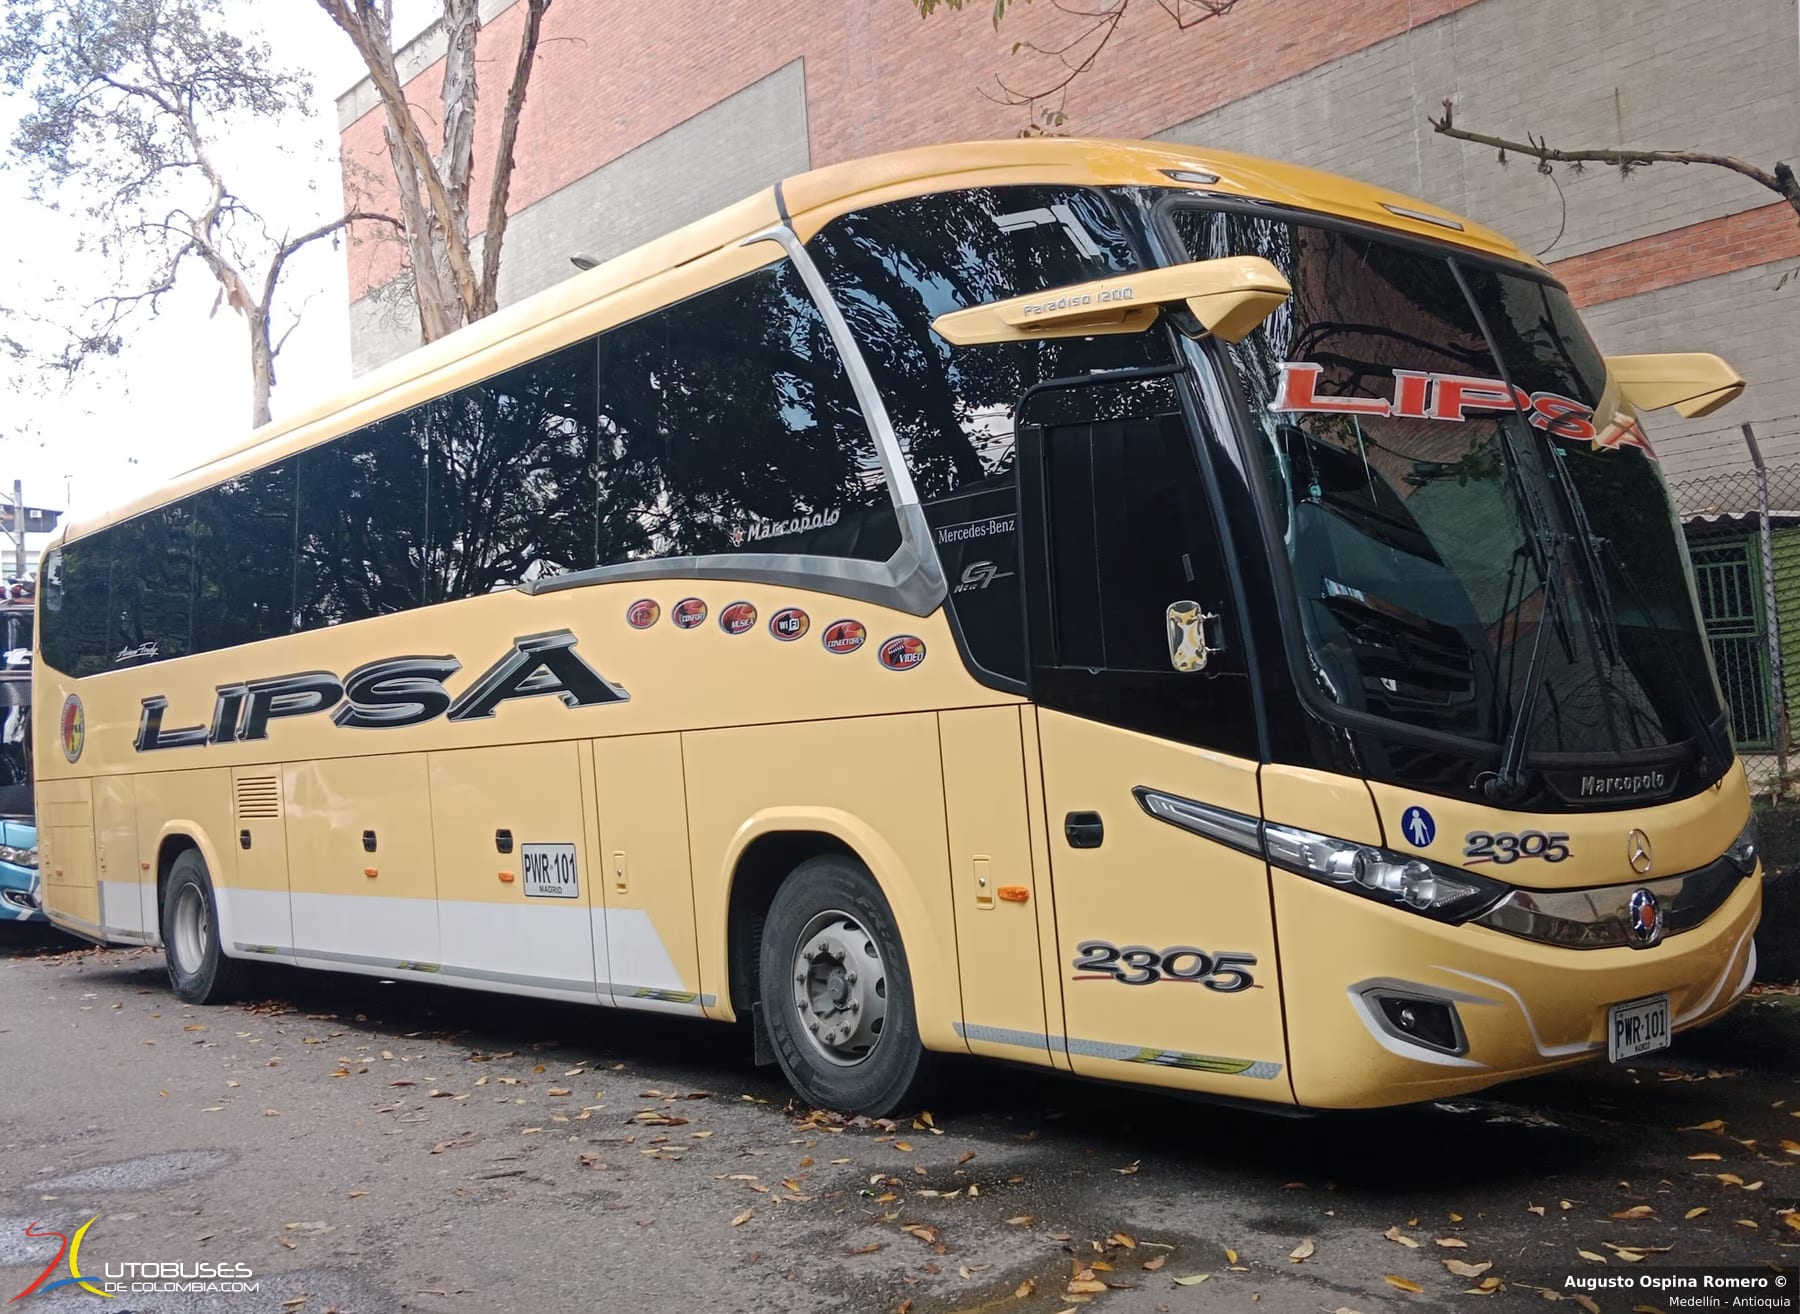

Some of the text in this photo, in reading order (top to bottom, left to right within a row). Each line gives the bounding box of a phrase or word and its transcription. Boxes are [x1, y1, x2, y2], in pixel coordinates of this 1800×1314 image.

[1023, 287, 1134, 316] Paradiso 1200
[1268, 362, 1657, 463] LIPSA
[747, 508, 840, 542] Marcopolo
[938, 520, 1015, 544] Mercedes-Benz
[899, 652, 923, 663] VIDEO
[132, 628, 631, 753] LIPSA
[1580, 771, 1665, 796] Marcopolo
[1463, 830, 1571, 865] 2305
[1072, 939, 1258, 993] 2305
